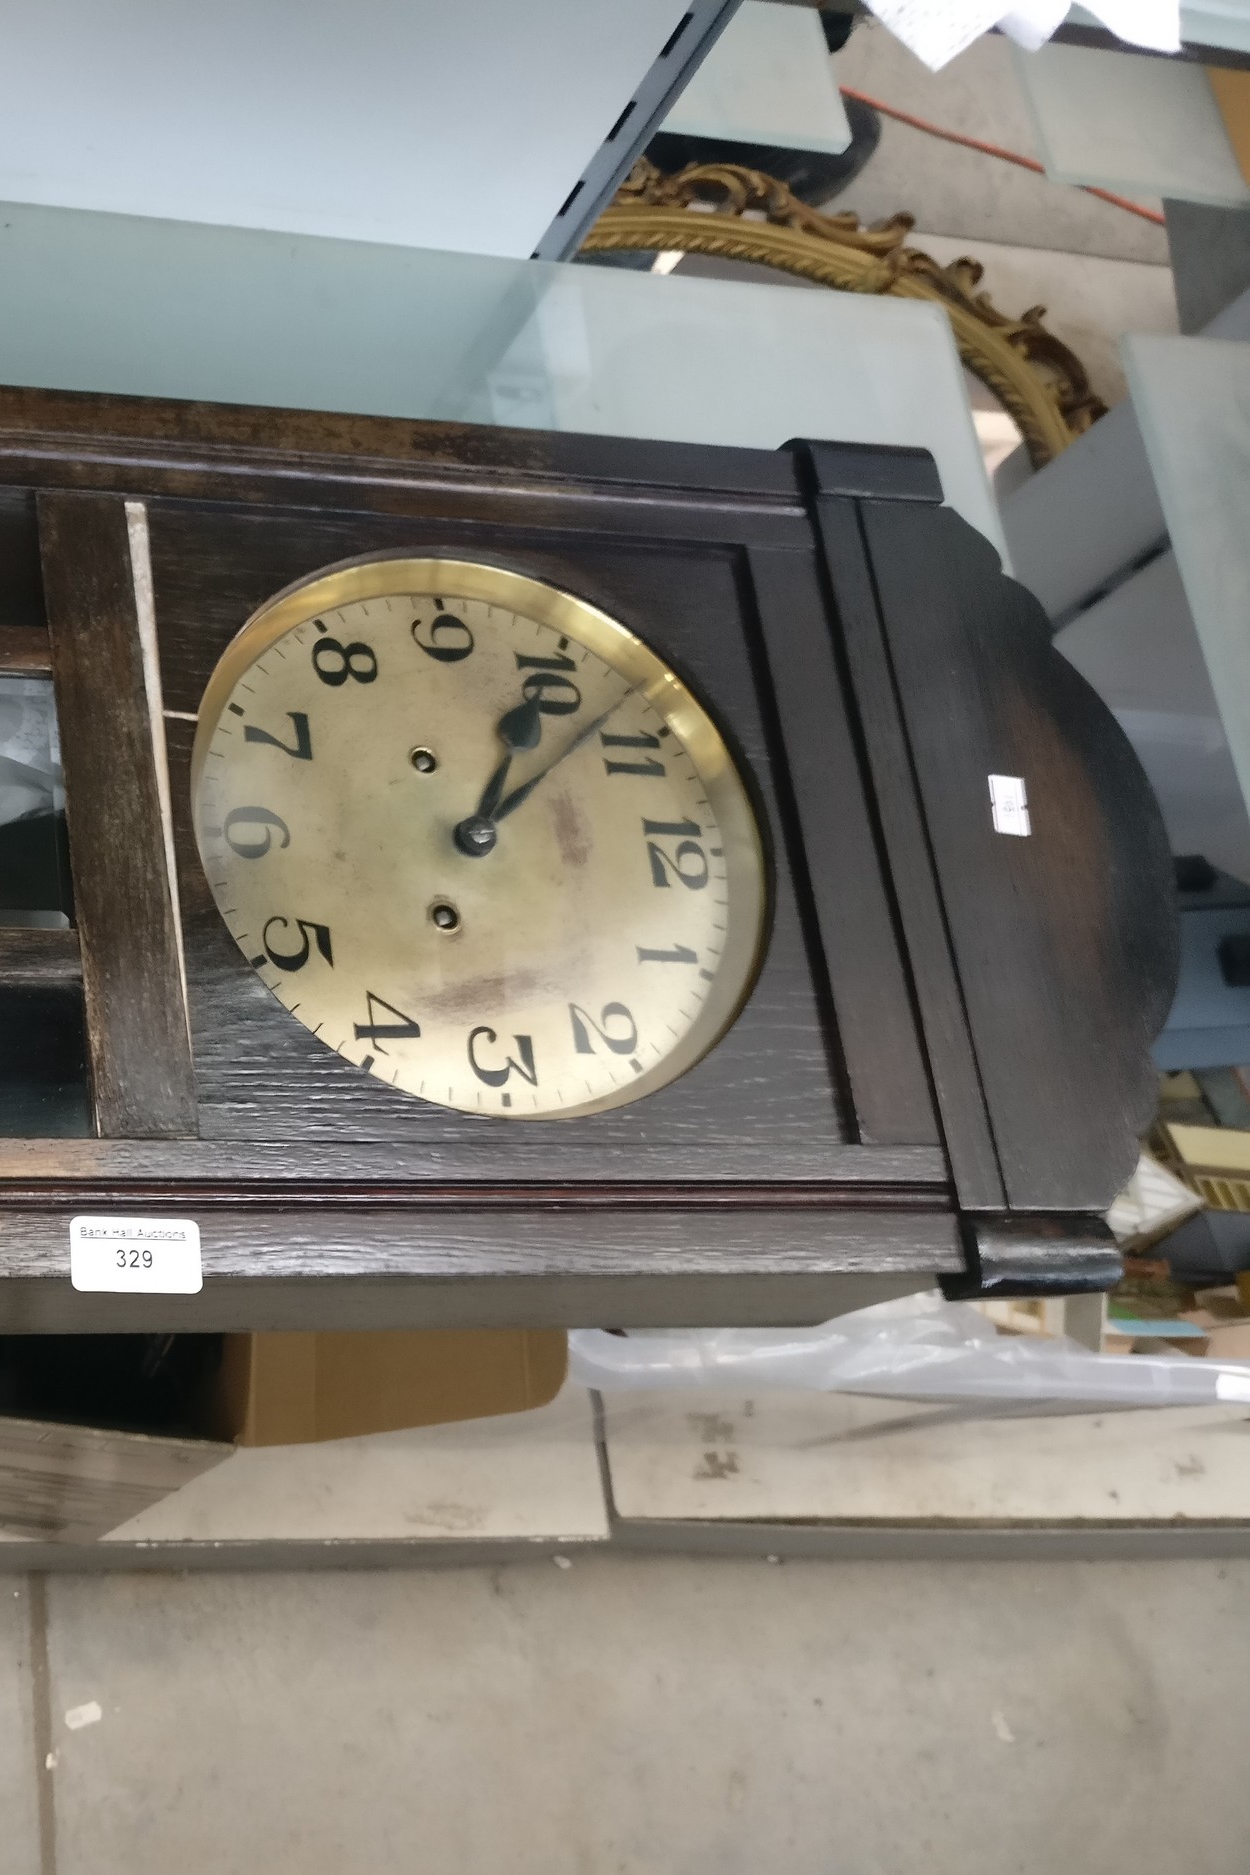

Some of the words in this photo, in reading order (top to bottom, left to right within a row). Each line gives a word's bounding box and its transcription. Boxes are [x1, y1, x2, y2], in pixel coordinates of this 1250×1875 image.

[311, 636, 378, 687] 8
[410, 613, 475, 663] 9
[514, 650, 582, 717] 10
[244, 711, 313, 762] 7
[600, 729, 667, 778] 11
[223, 805, 291, 860] 6
[641, 816, 710, 891] 12
[262, 915, 334, 972] 5
[636, 942, 700, 966] 1
[353, 990, 421, 1055] 4
[568, 1001, 638, 1056] 2
[467, 1026, 539, 1088] 3
[80, 1226, 108, 1237] Bank
[112, 1228, 133, 1238] Hall
[137, 1228, 186, 1239] Auctions
[116, 1249, 153, 1269] 329
